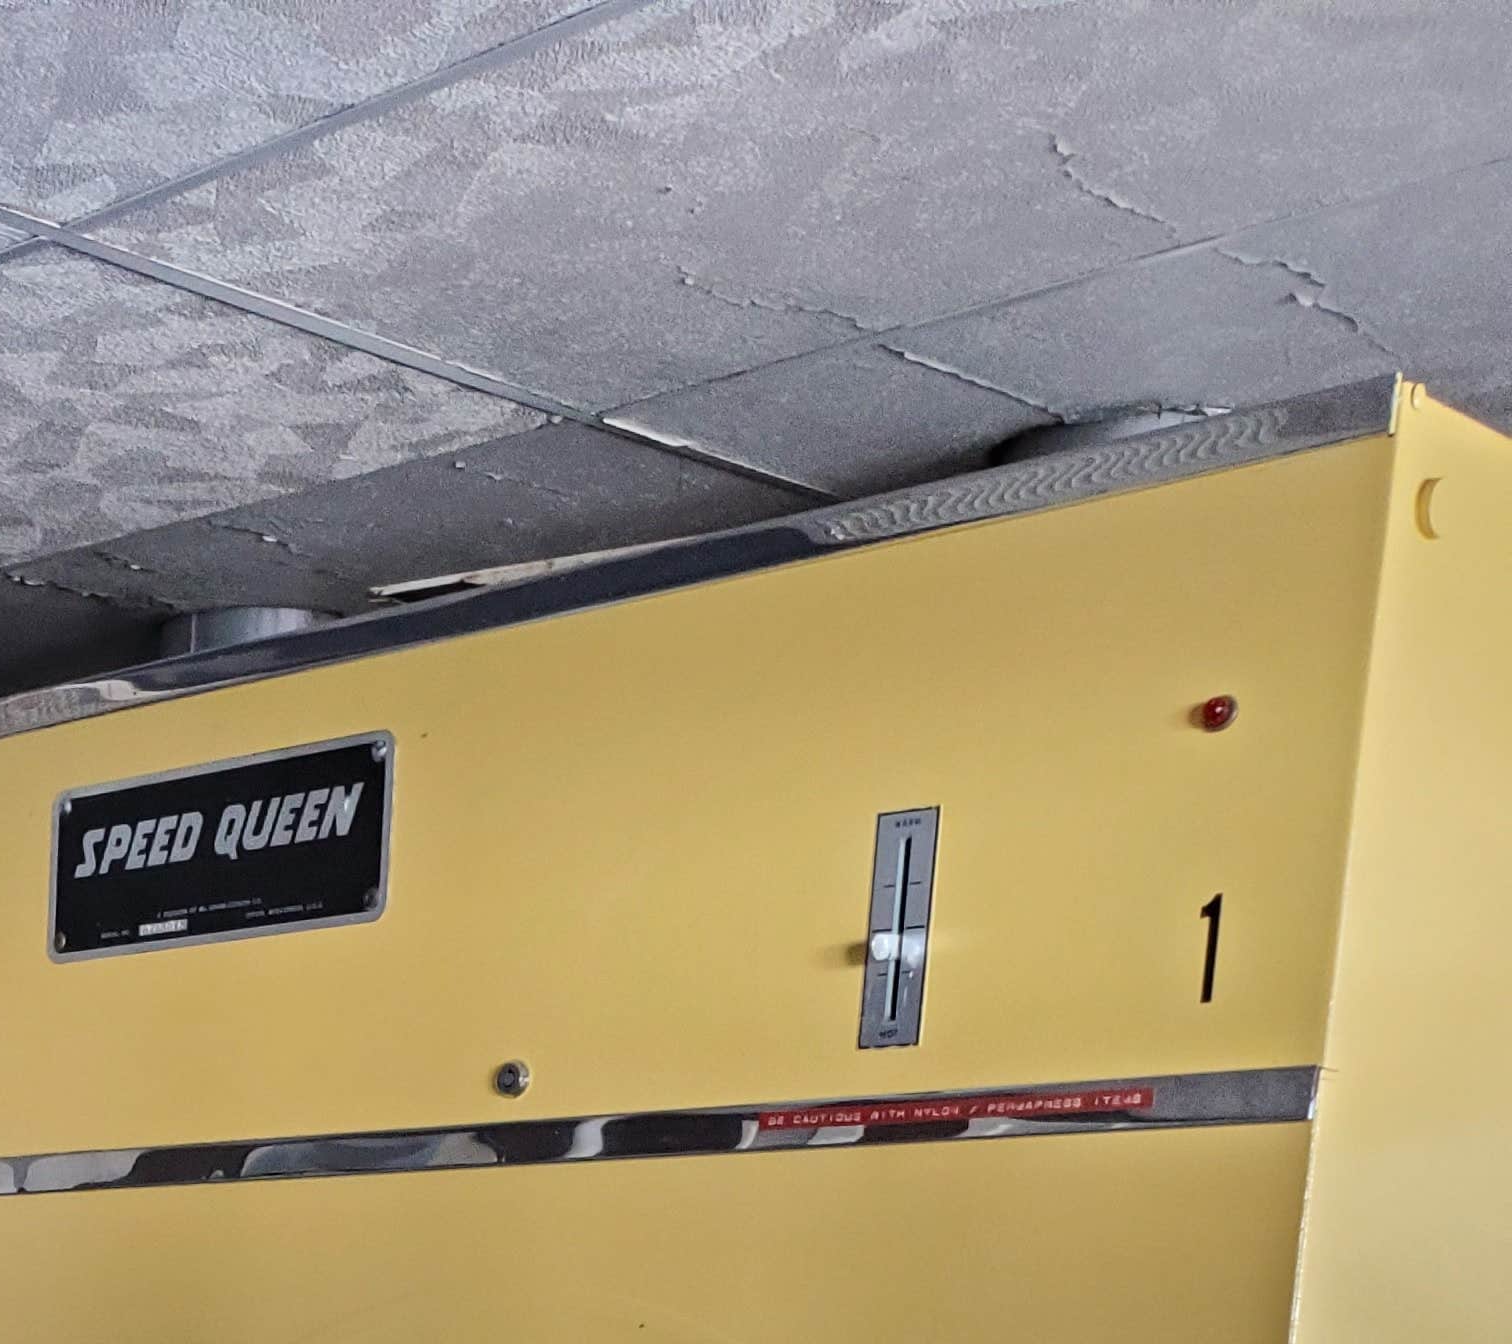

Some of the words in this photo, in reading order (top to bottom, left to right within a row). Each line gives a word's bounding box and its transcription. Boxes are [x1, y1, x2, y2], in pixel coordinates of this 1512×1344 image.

[74, 811, 204, 879] SPEED
[213, 782, 365, 861] QUEEN
[1200, 893, 1223, 1003] 1
[768, 1115, 784, 1126] BE
[792, 1111, 862, 1125] CAUTIOUS
[913, 1105, 960, 1118] NYLON
